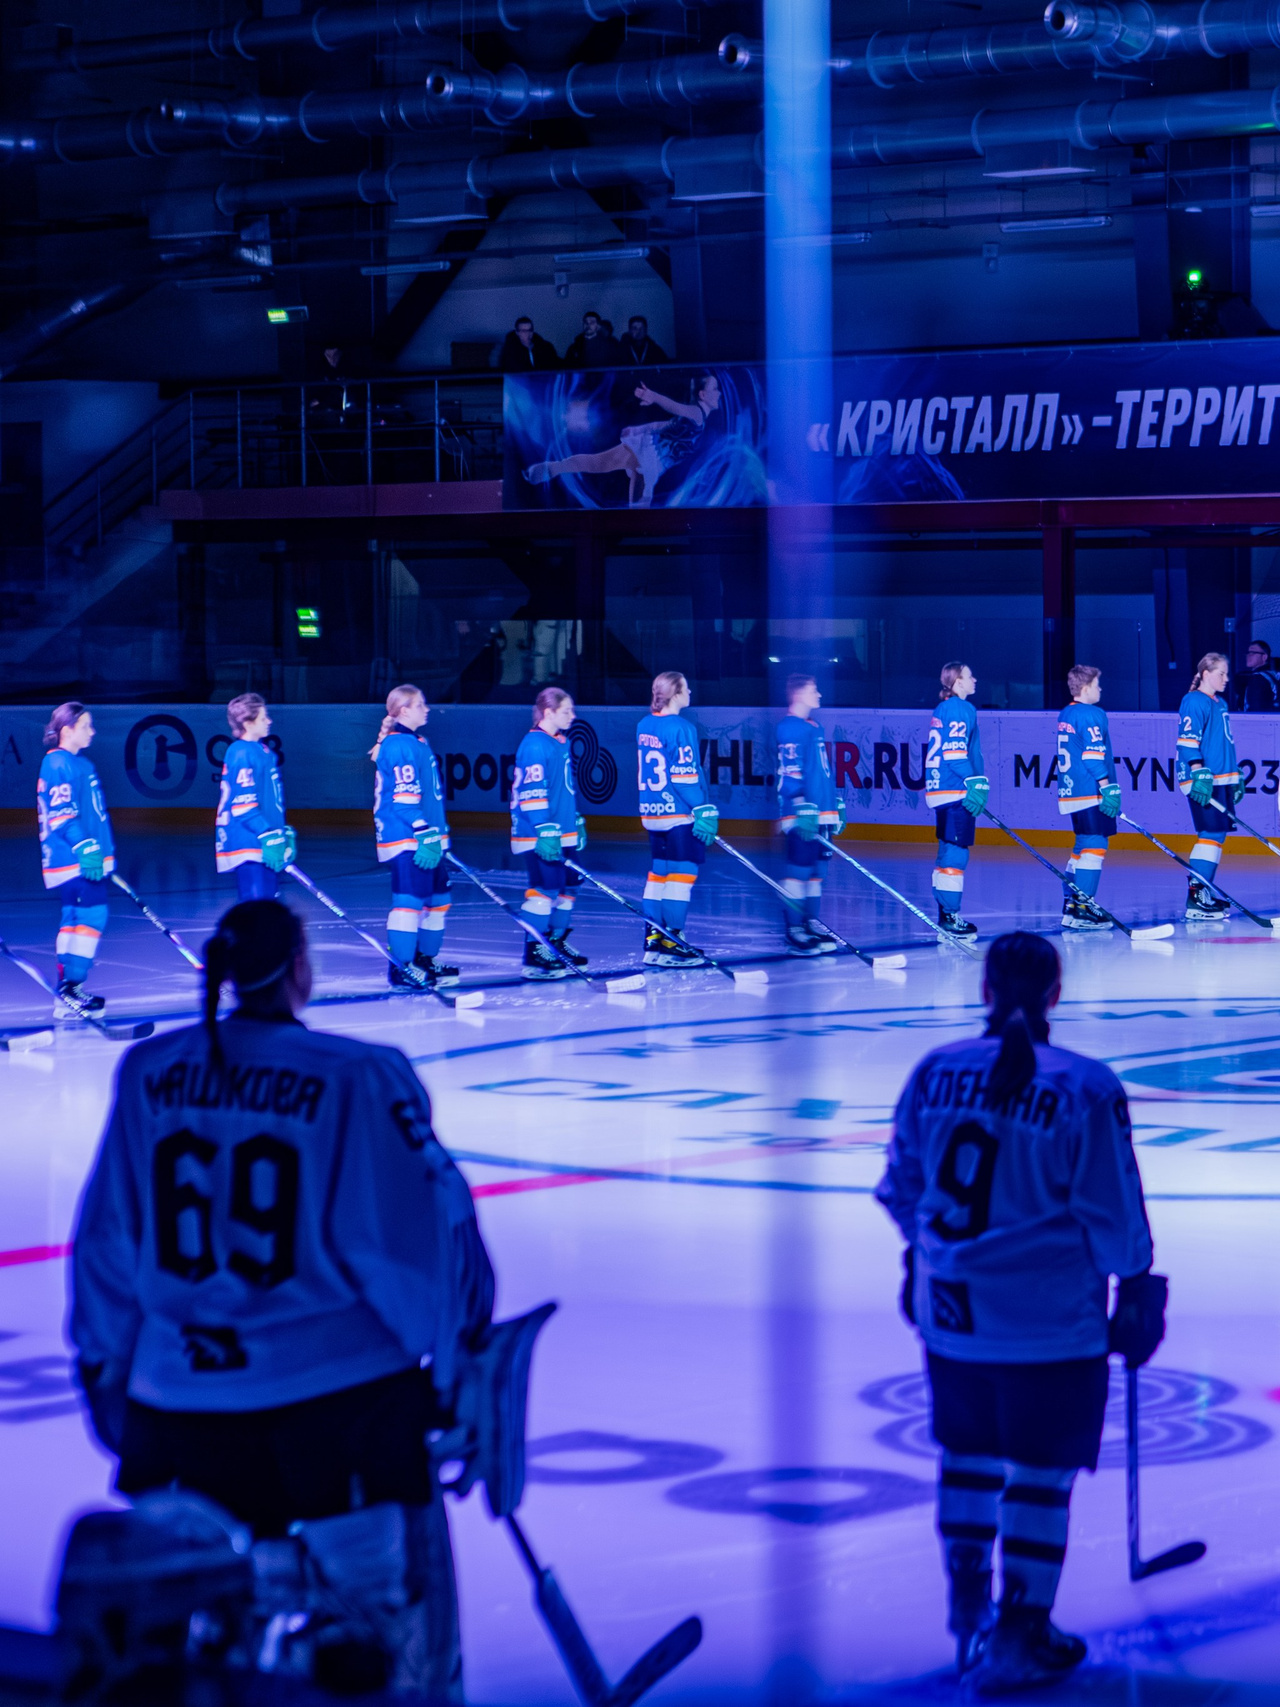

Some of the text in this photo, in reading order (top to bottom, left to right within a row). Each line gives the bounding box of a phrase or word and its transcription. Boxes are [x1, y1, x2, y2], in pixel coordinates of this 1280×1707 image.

[948, 721, 967, 738] 22
[1087, 726, 1103, 743] 15
[678, 745, 694, 764] 13
[393, 764, 415, 784] 18
[48, 783, 72, 807] 29
[930, 1119, 999, 1242] 9
[153, 1127, 300, 1290] 69
